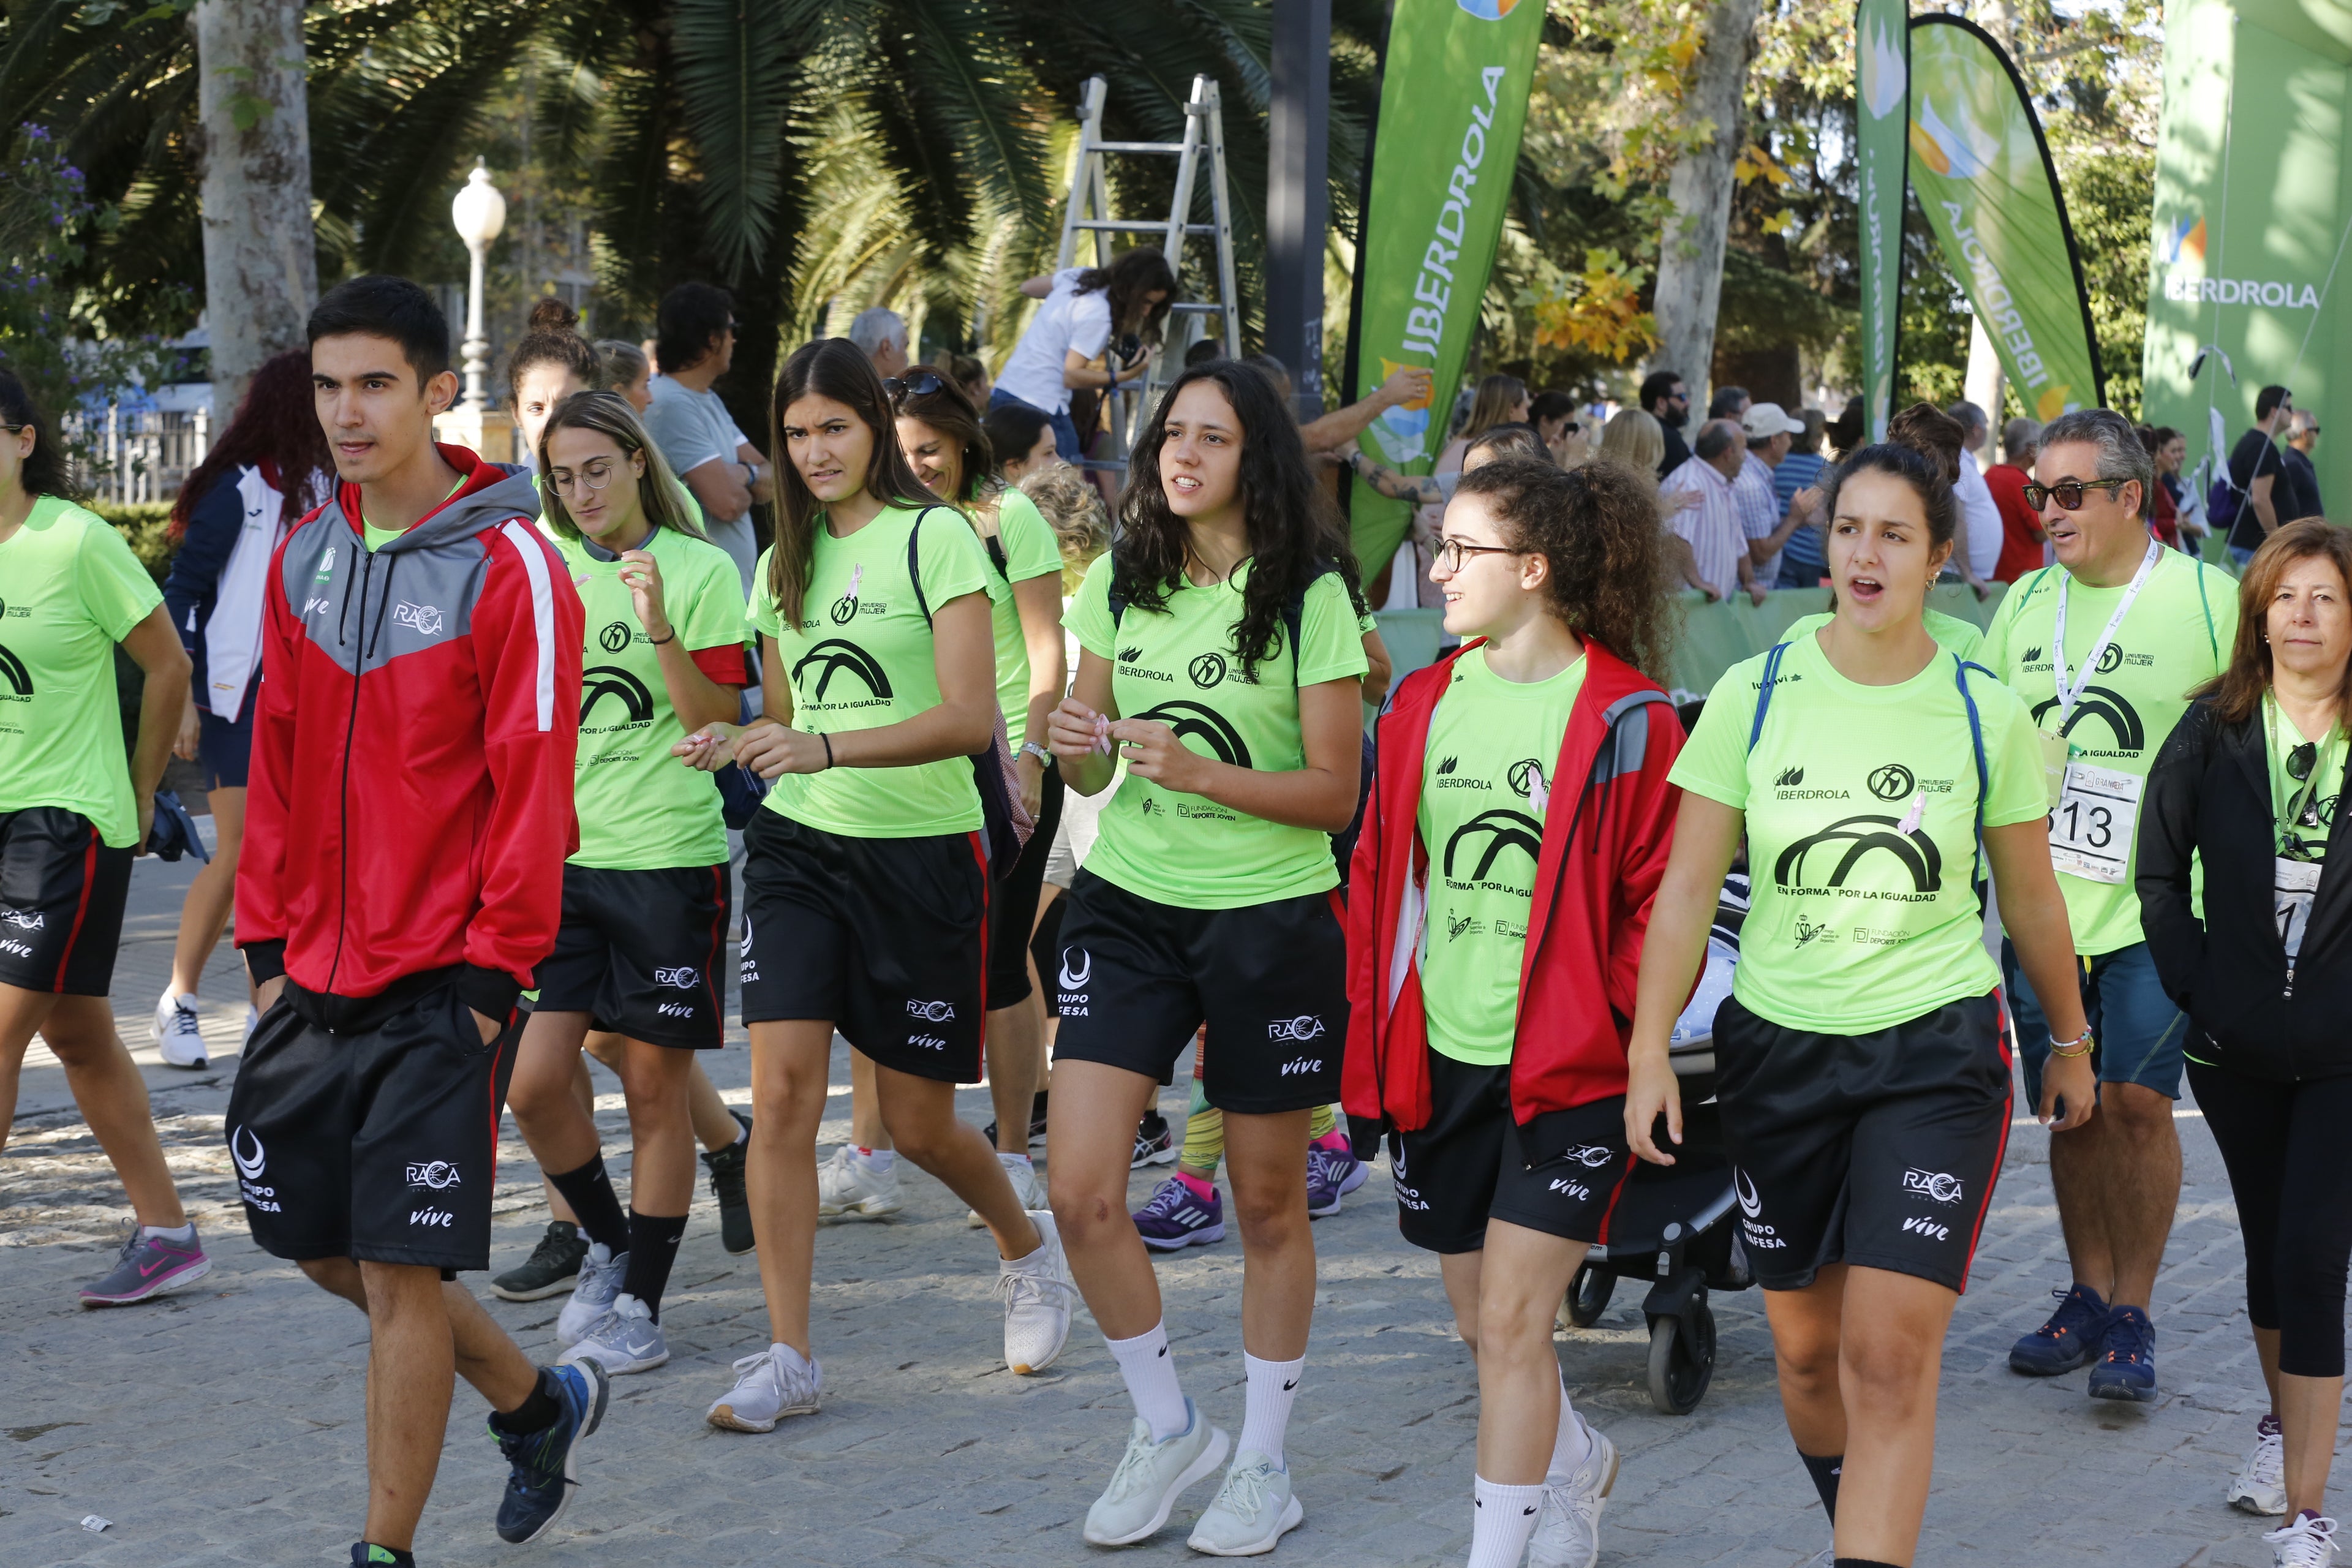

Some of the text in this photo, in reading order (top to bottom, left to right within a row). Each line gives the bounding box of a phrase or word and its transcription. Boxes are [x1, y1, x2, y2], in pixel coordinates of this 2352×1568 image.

[1402, 66, 1505, 358] IBERDROLA
[2165, 275, 2320, 309] IBERDROLA
[2124, 658, 2154, 667] MUJER
[1118, 665, 1174, 682] IBERDROLA
[0, 694, 32, 703] GUALDAD
[850, 699, 891, 708] IGUALDAD
[607, 722, 650, 733] IGUALDAD
[1436, 778, 1493, 790] IBERDROLA
[1776, 790, 1850, 800] IBERDROLA
[1191, 805, 1227, 814] FUNDACIÓN
[1481, 882, 1502, 891] POR
[1504, 885, 1515, 894] LA
[1777, 886, 1937, 903] EN FORMA POR LA IGUALDAD
[1871, 929, 1910, 937] FUNDACIÓN
[655, 967, 700, 989] RACA
[907, 1000, 955, 1022] RACA
[1268, 1016, 1325, 1041] RACA
[407, 1161, 461, 1189] RACA
[1902, 1170, 1962, 1202] RACA
[1743, 1218, 1775, 1235] GRUPO
